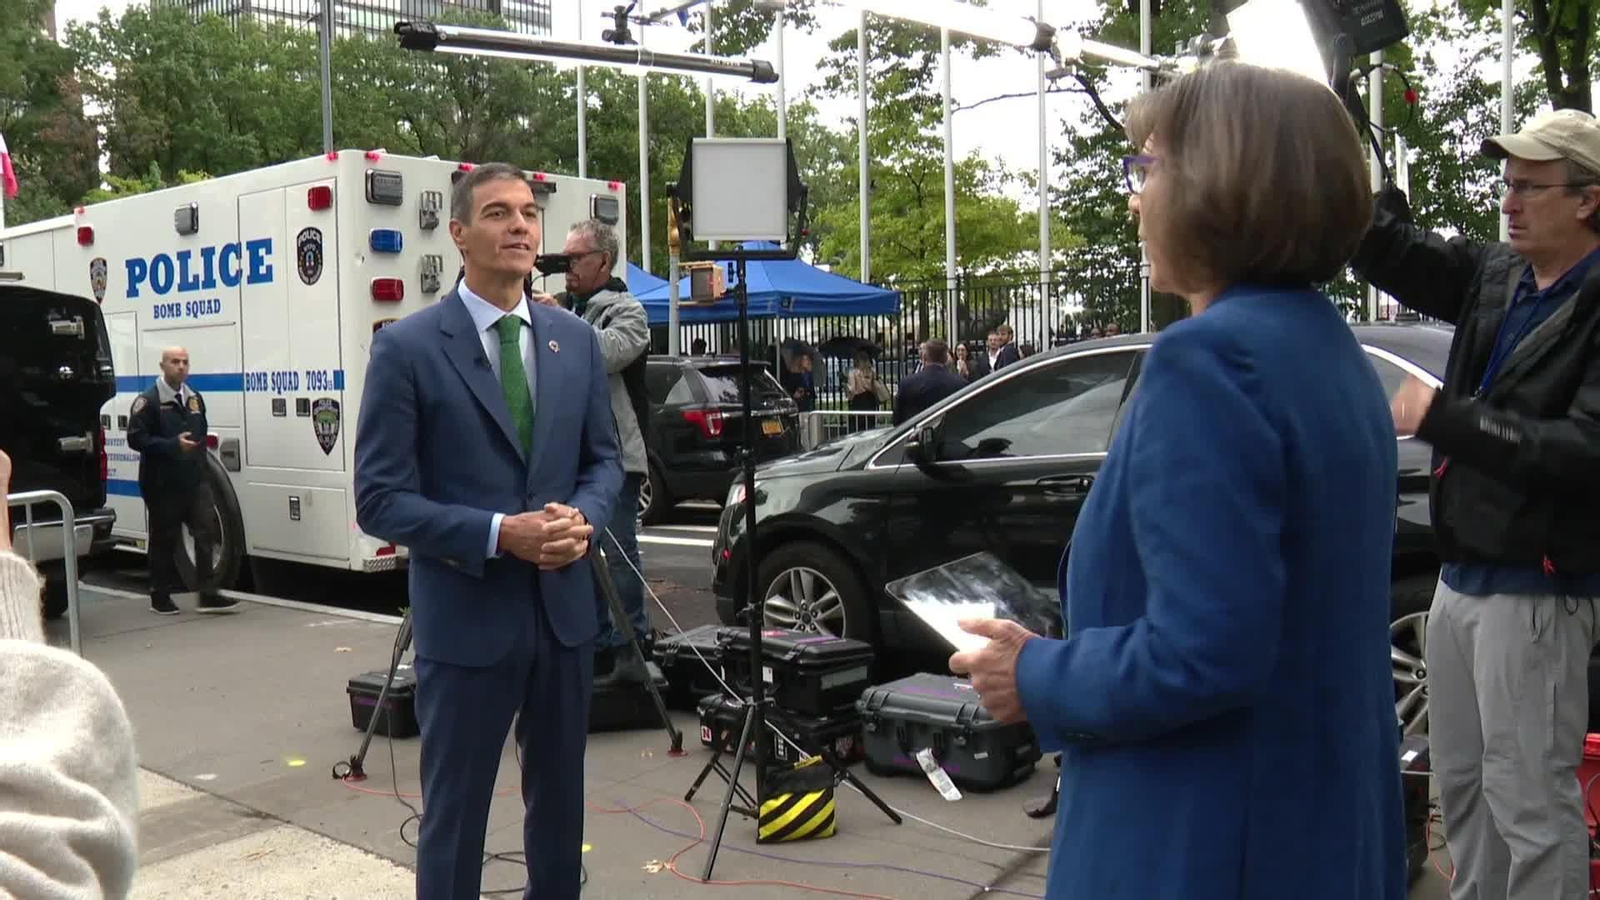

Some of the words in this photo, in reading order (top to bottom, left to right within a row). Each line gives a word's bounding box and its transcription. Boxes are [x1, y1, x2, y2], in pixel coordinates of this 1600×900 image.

[125, 237, 273, 298] POLICE
[153, 303, 182, 319] BOMB
[185, 299, 221, 318] SQUAD
[245, 372, 268, 392] BOMB
[271, 371, 299, 395] SQUAD
